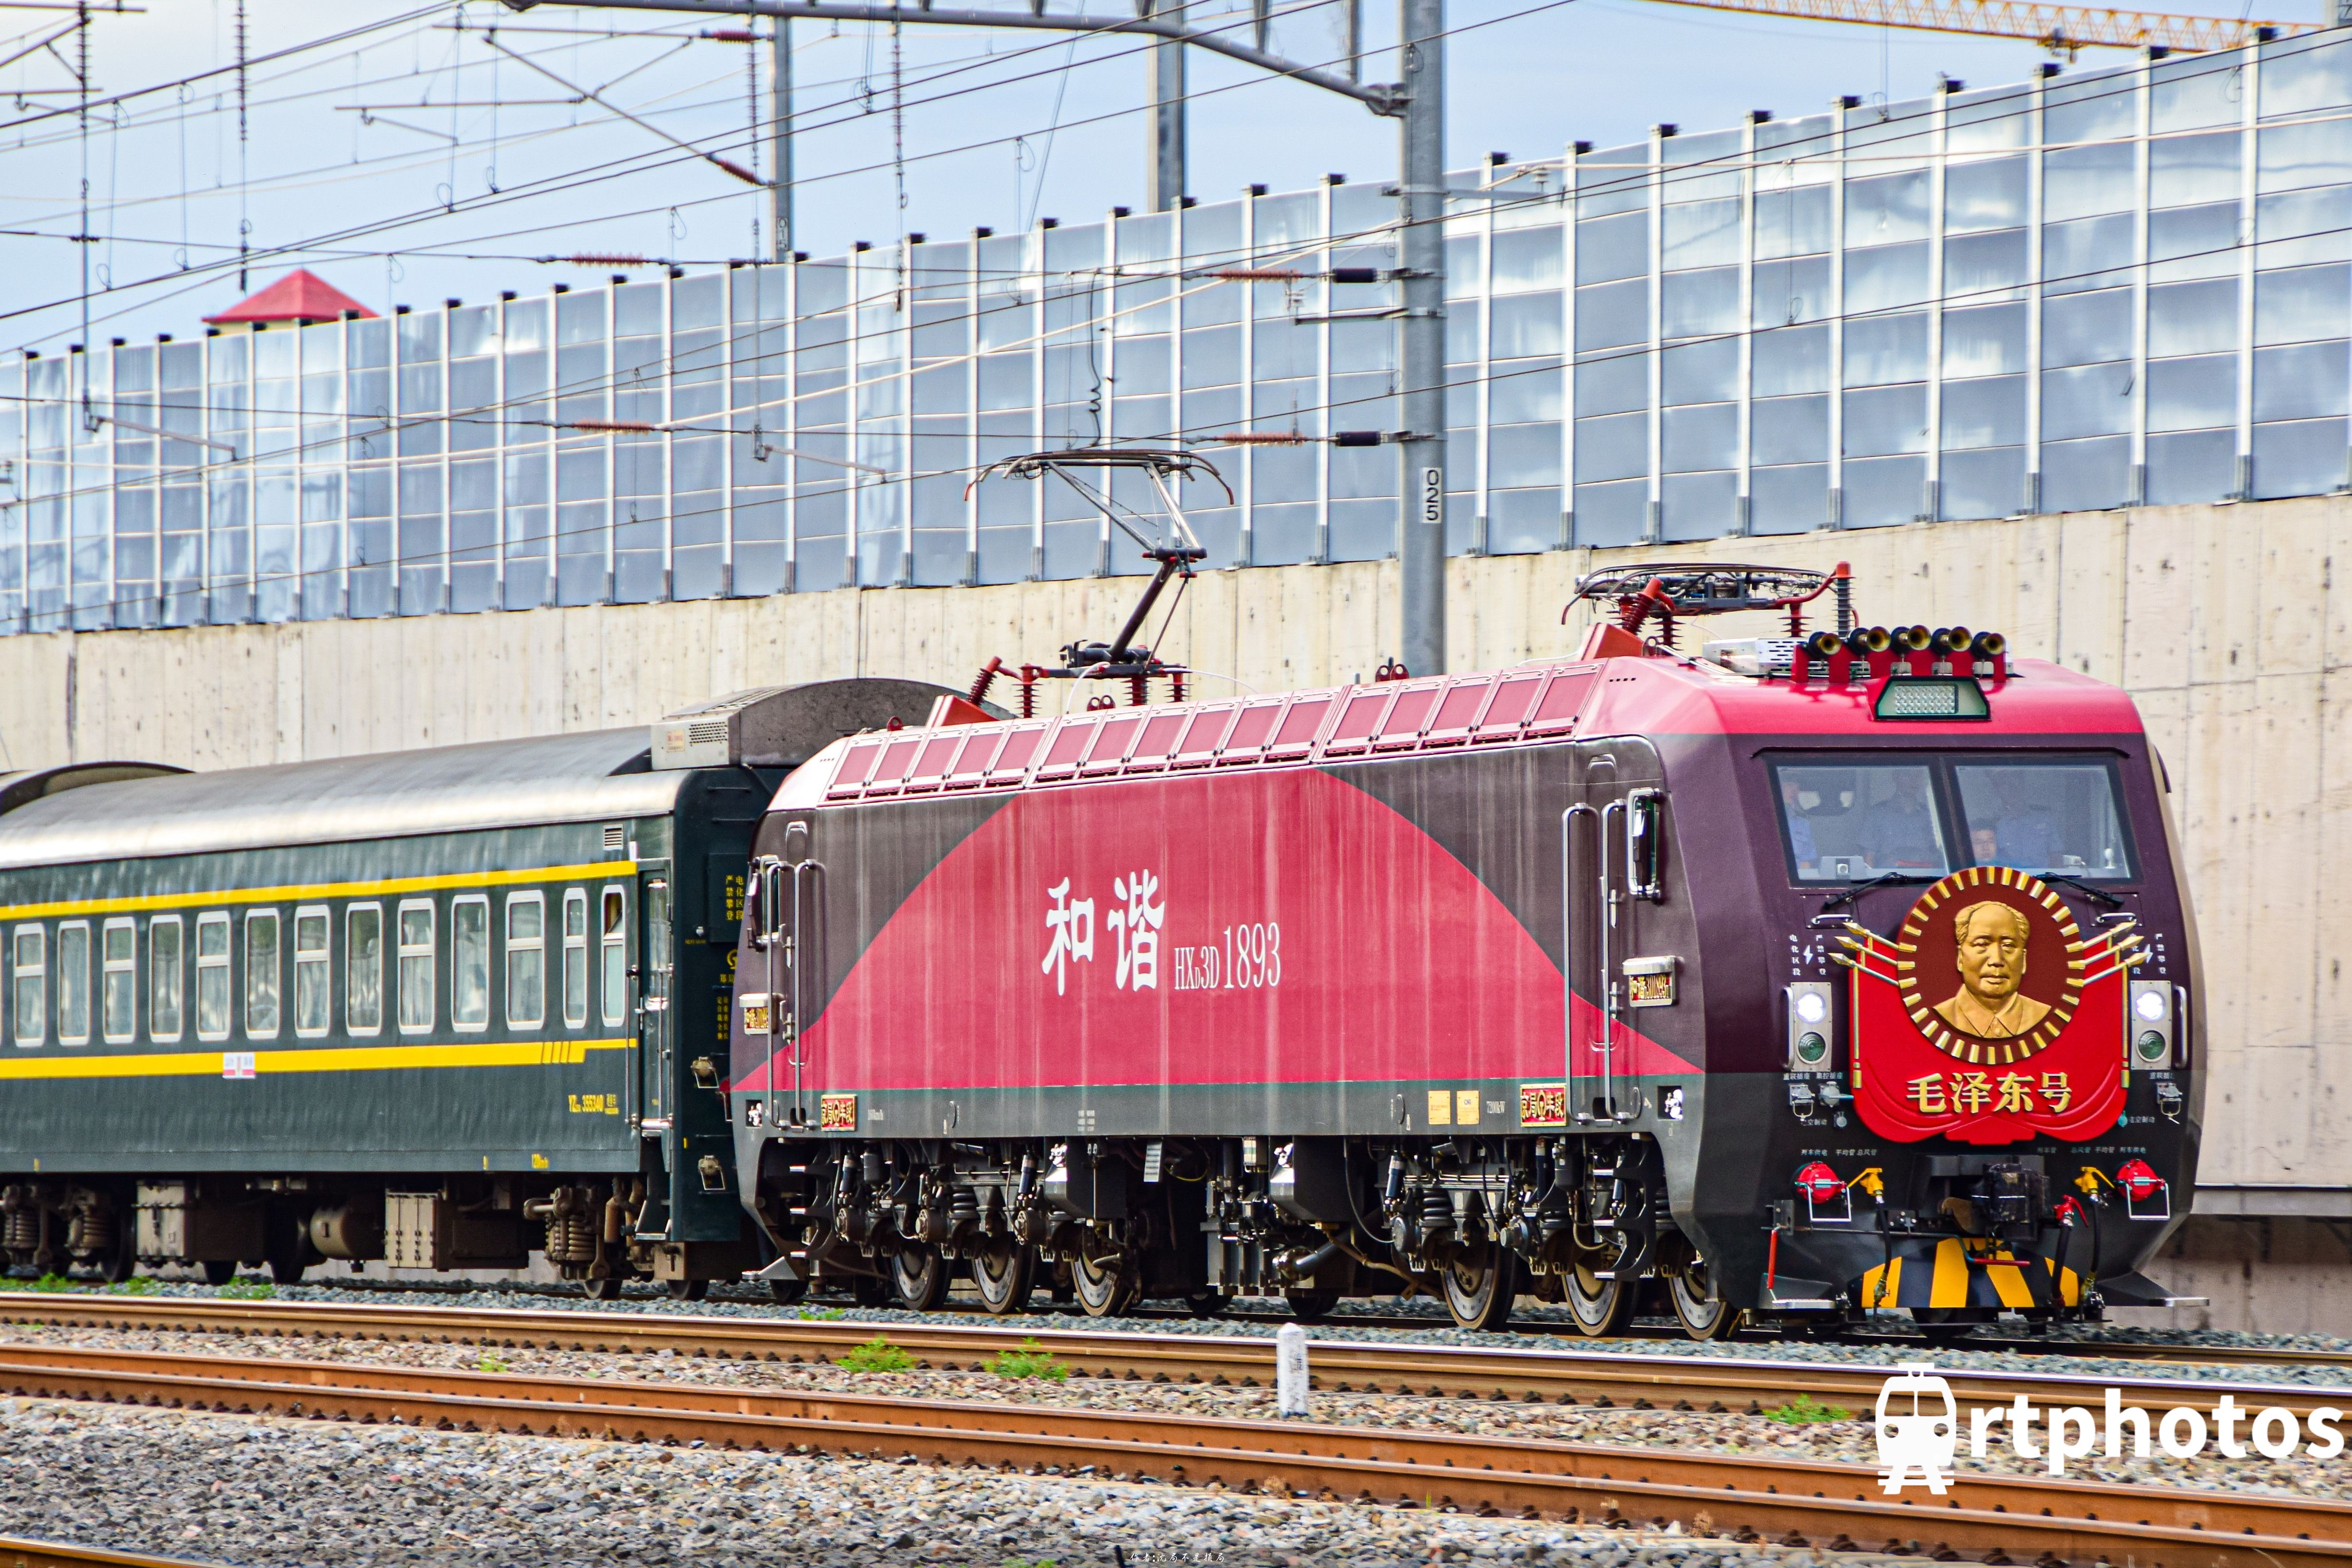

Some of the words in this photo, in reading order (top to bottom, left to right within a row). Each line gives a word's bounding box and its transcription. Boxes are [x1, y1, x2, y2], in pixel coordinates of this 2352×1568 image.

[1426, 469, 1439, 521] 025
[736, 876, 744, 920] 电化区段
[1041, 869, 1165, 996] 和谐
[1224, 922, 1281, 989] 1893
[1789, 934, 1800, 975] 电化区段
[1906, 1071, 2073, 1114] 毛泽东号
